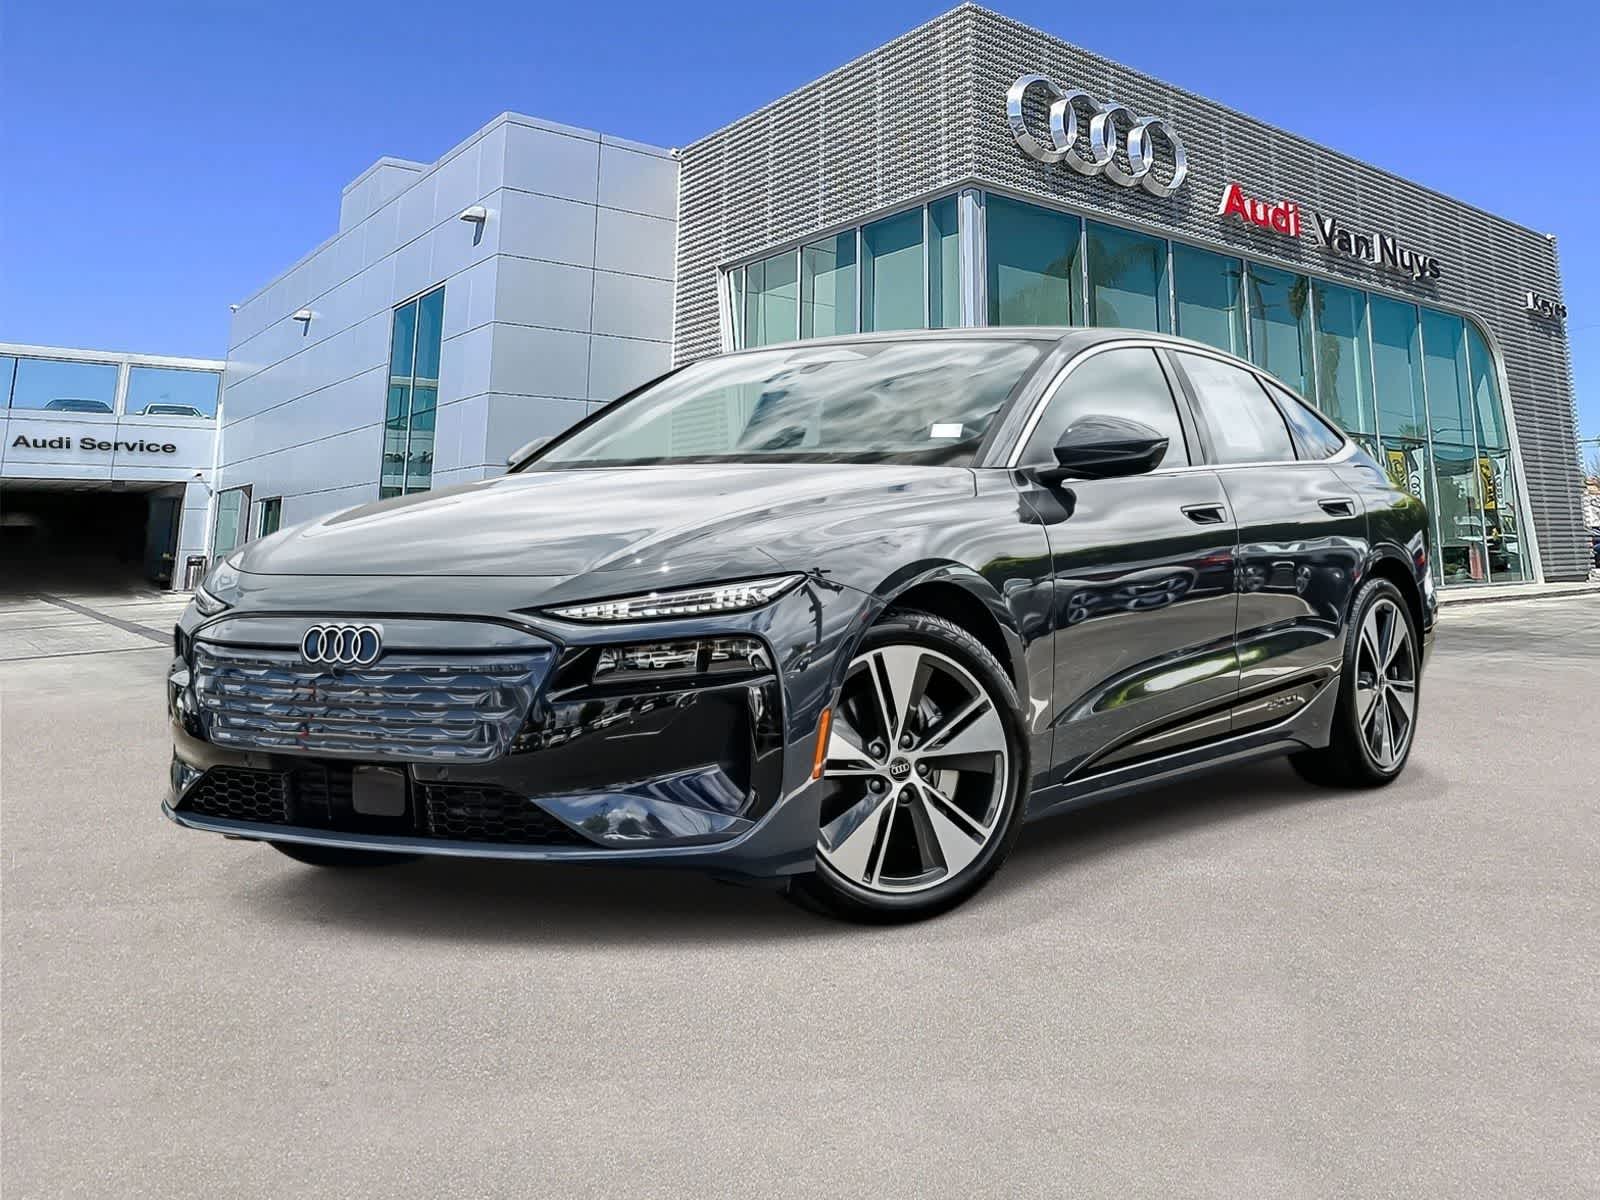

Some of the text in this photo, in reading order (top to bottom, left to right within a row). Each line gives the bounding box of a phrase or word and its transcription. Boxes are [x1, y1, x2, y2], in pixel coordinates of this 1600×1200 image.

[1218, 181, 1441, 280] Audi Van Nuys
[12, 435, 177, 454] Audi Service
